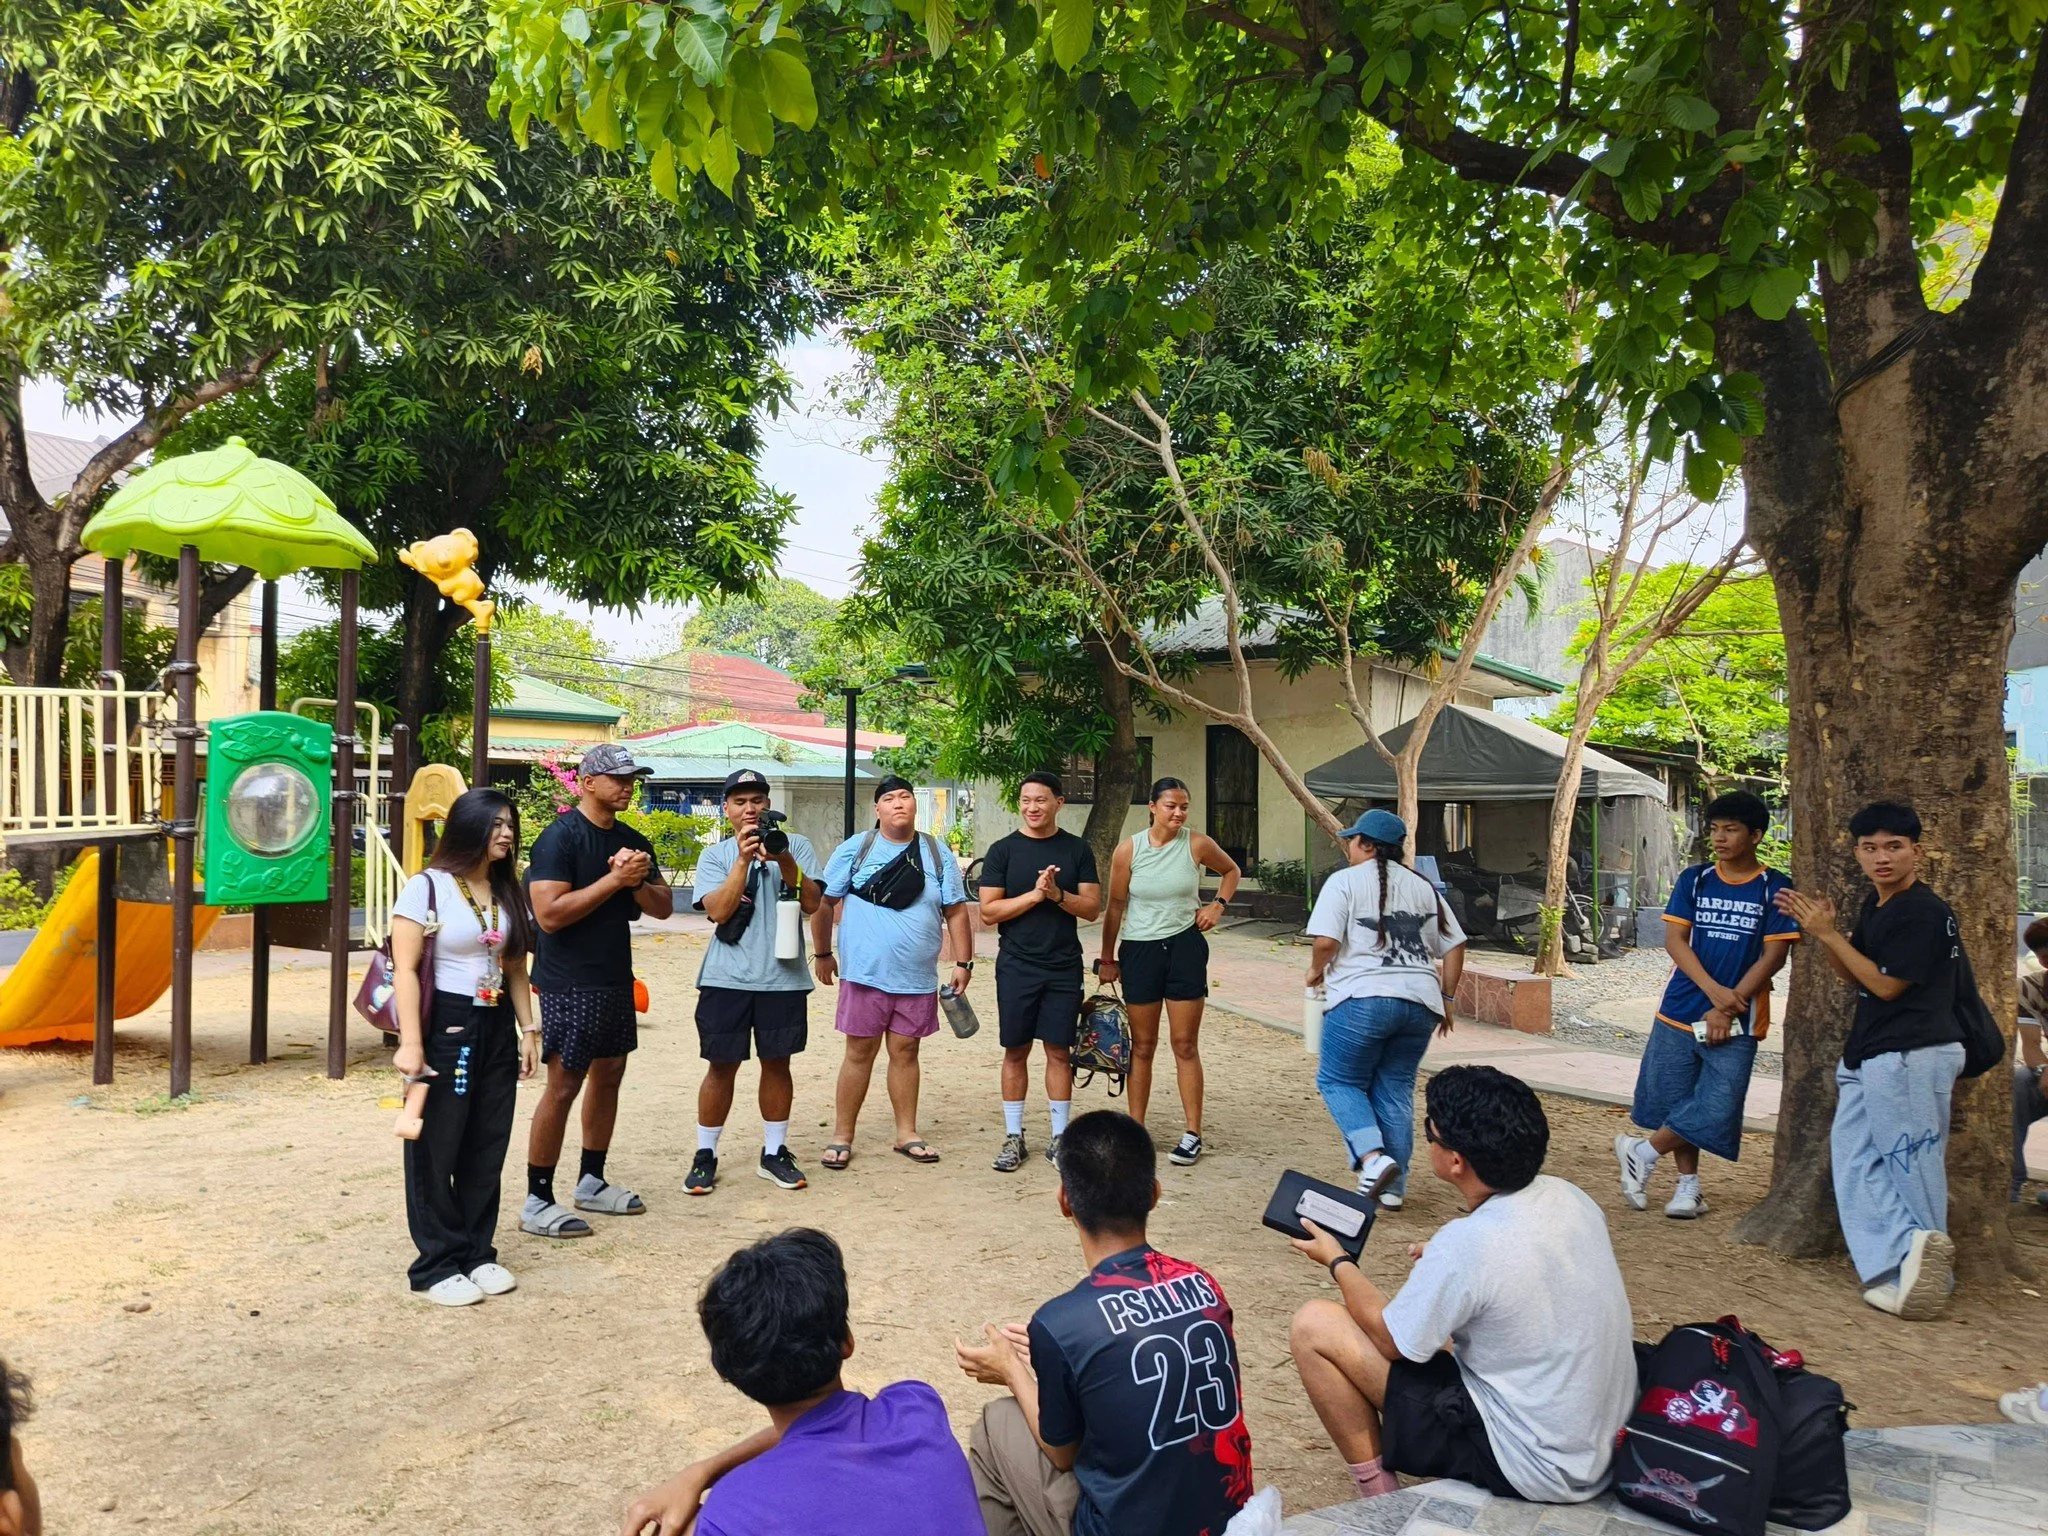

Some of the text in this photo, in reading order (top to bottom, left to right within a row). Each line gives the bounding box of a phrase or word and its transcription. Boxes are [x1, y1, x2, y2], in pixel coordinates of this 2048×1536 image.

[1695, 910, 1759, 930] COLLEGE
[1707, 930, 1740, 941] WUSHU
[1098, 1272, 1219, 1335] PSALMS
[1131, 1319, 1239, 1450] 23
